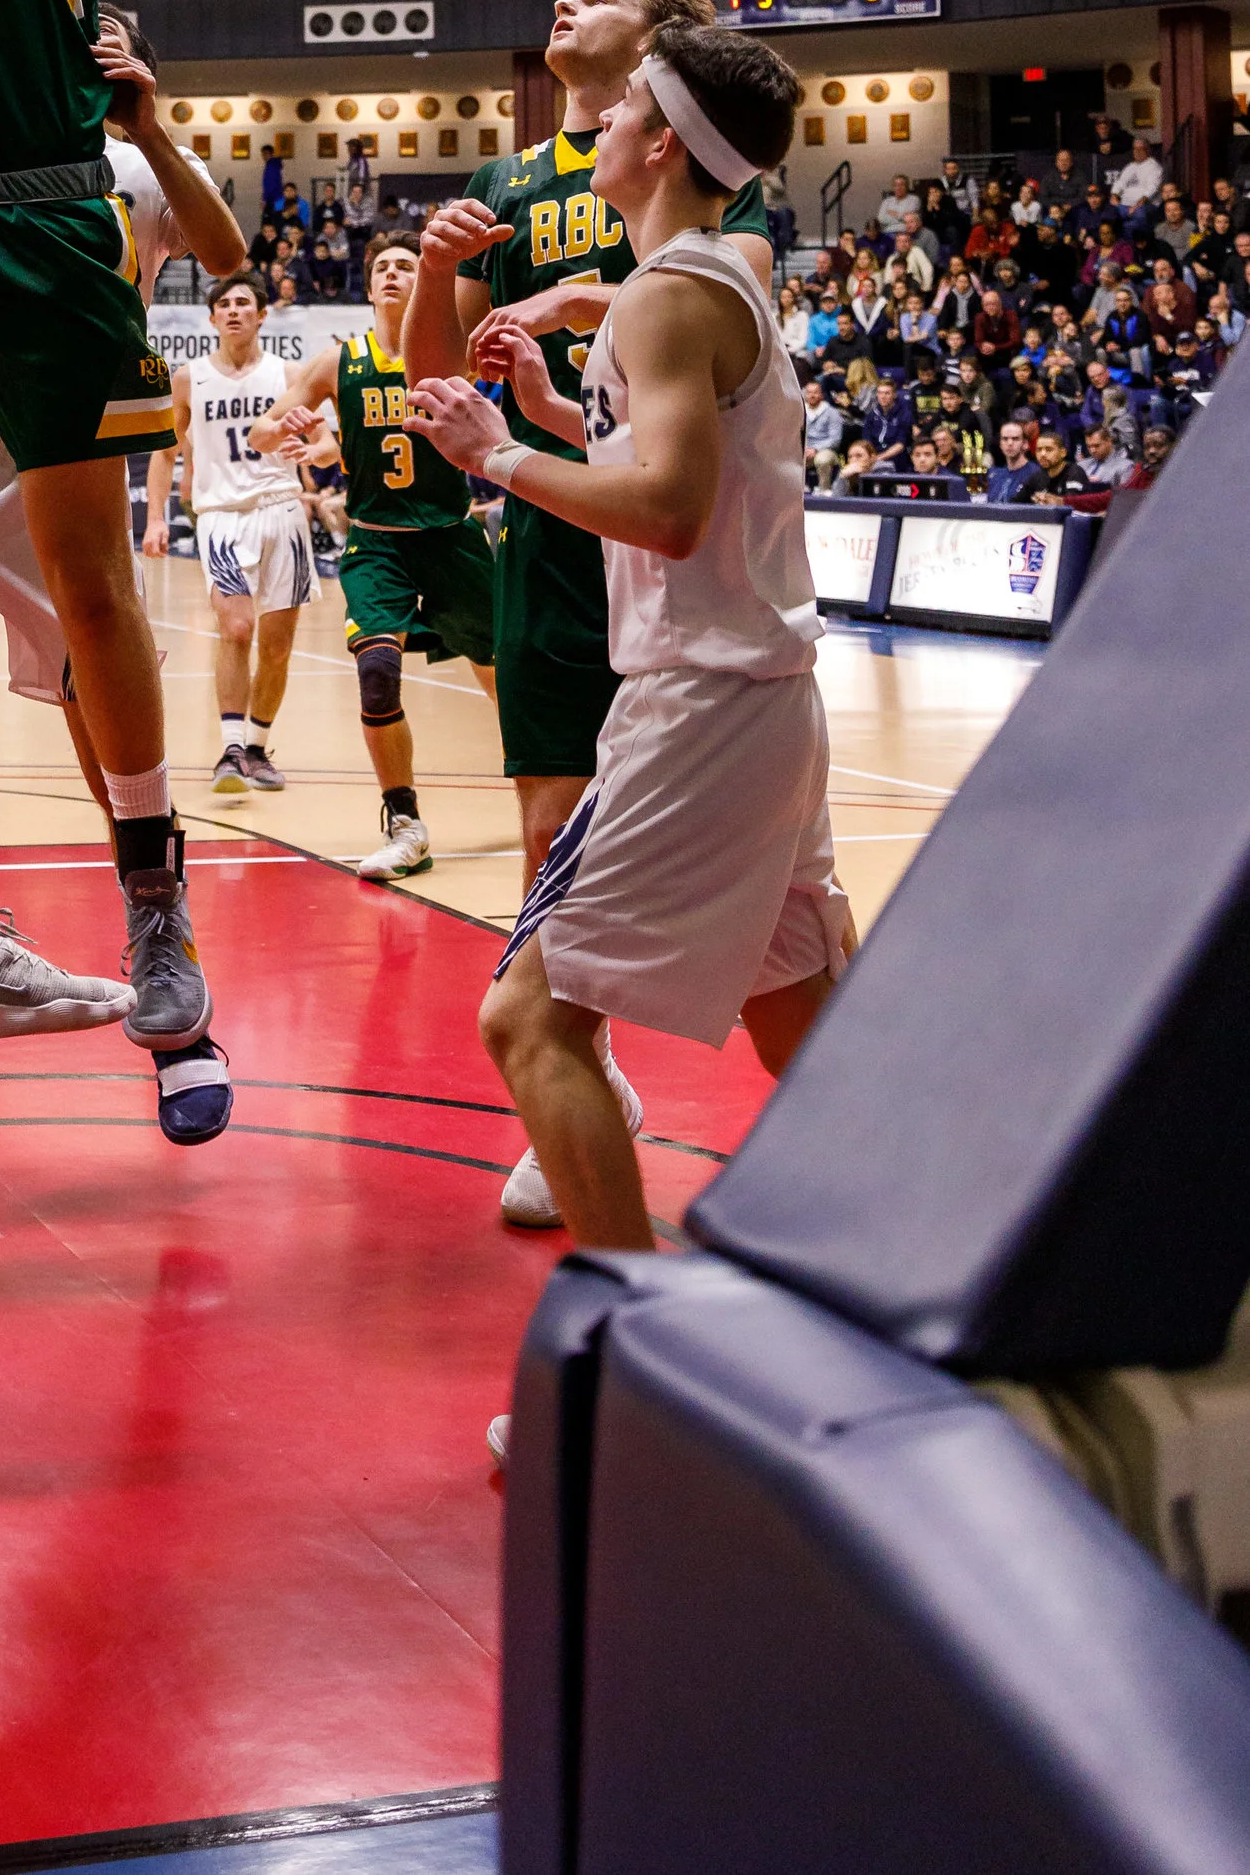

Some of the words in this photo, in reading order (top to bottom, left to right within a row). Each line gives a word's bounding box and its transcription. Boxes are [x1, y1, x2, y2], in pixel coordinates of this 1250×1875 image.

[529, 190, 624, 268] RBC
[205, 396, 276, 422] EAGLES
[380, 433, 415, 490] 3
